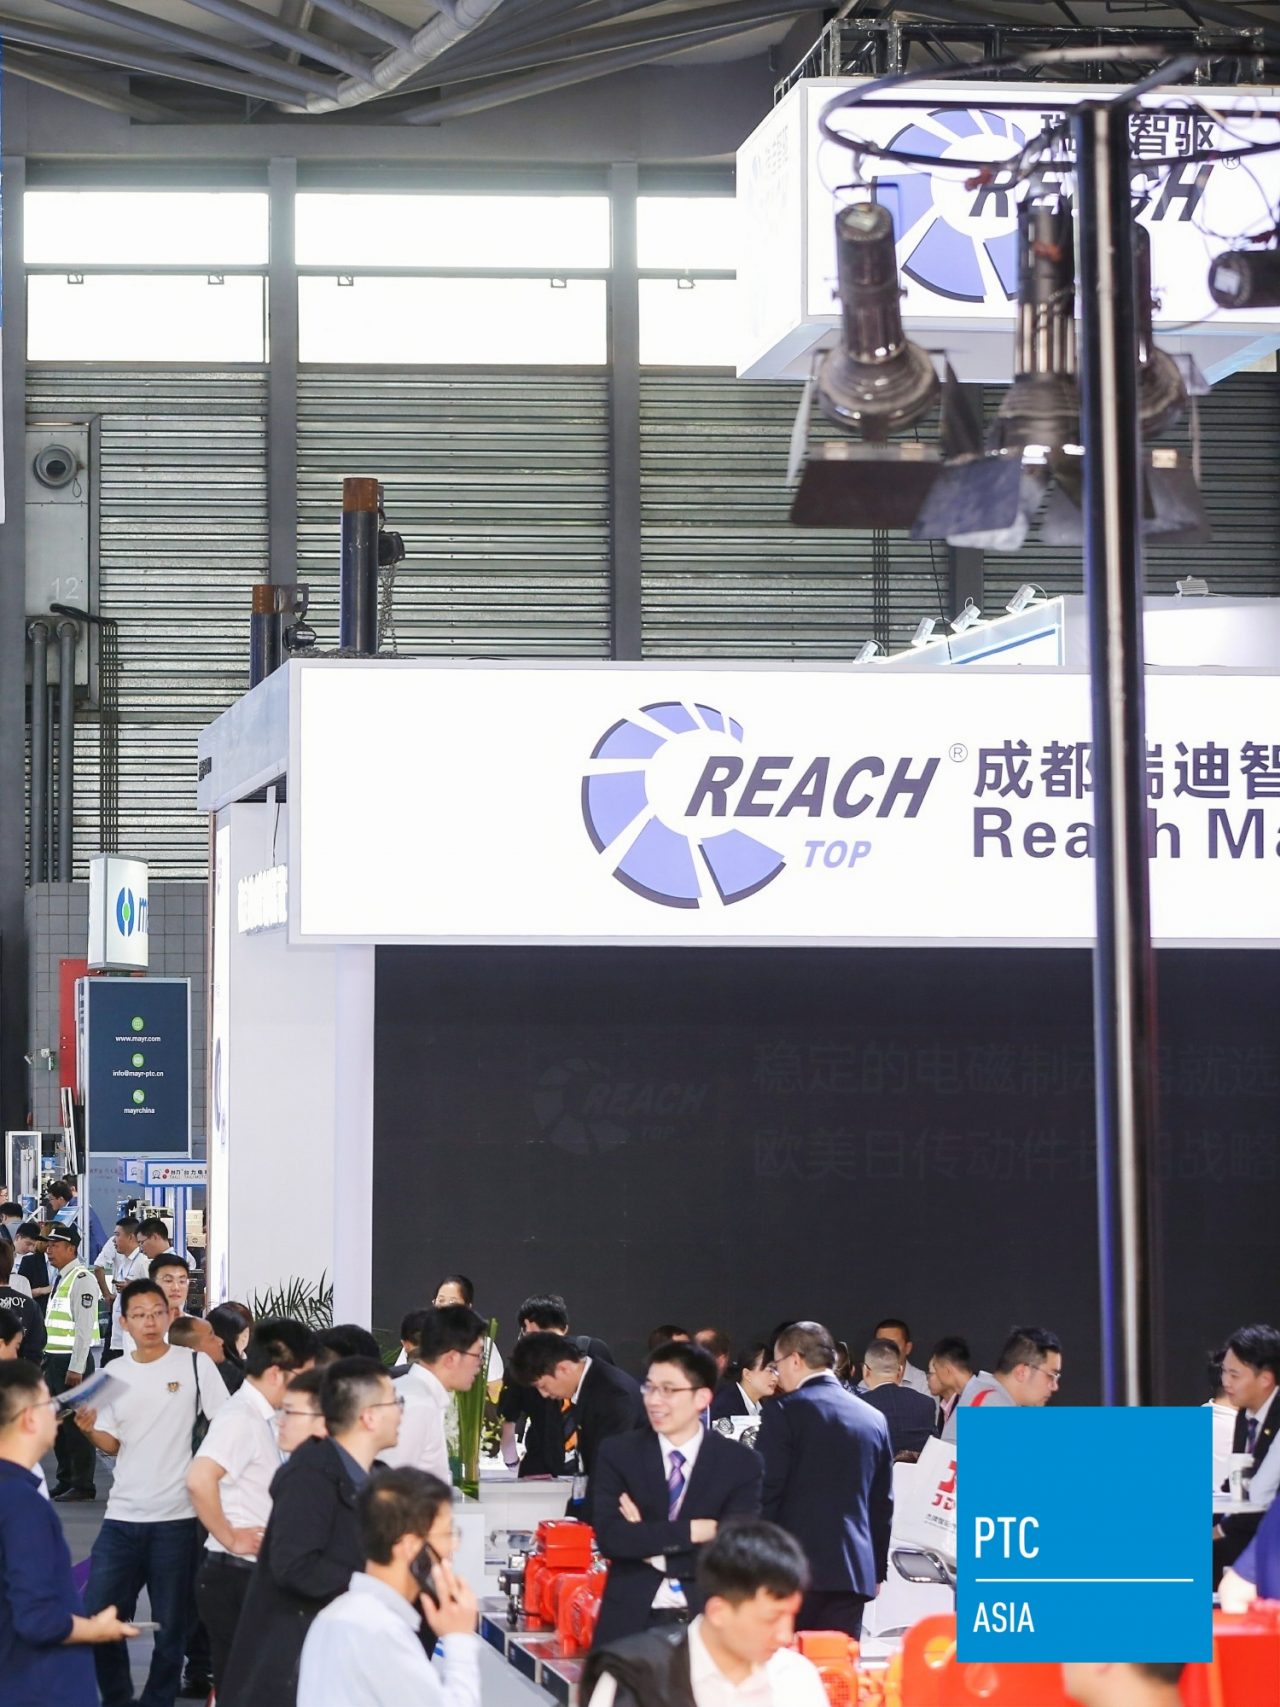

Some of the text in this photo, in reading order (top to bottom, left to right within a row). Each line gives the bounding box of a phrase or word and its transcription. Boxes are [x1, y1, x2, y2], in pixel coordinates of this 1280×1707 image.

[51, 577, 79, 601] 12
[683, 755, 942, 819] REACH
[973, 806, 1181, 859] Reah
[803, 839, 873, 868] TOP
